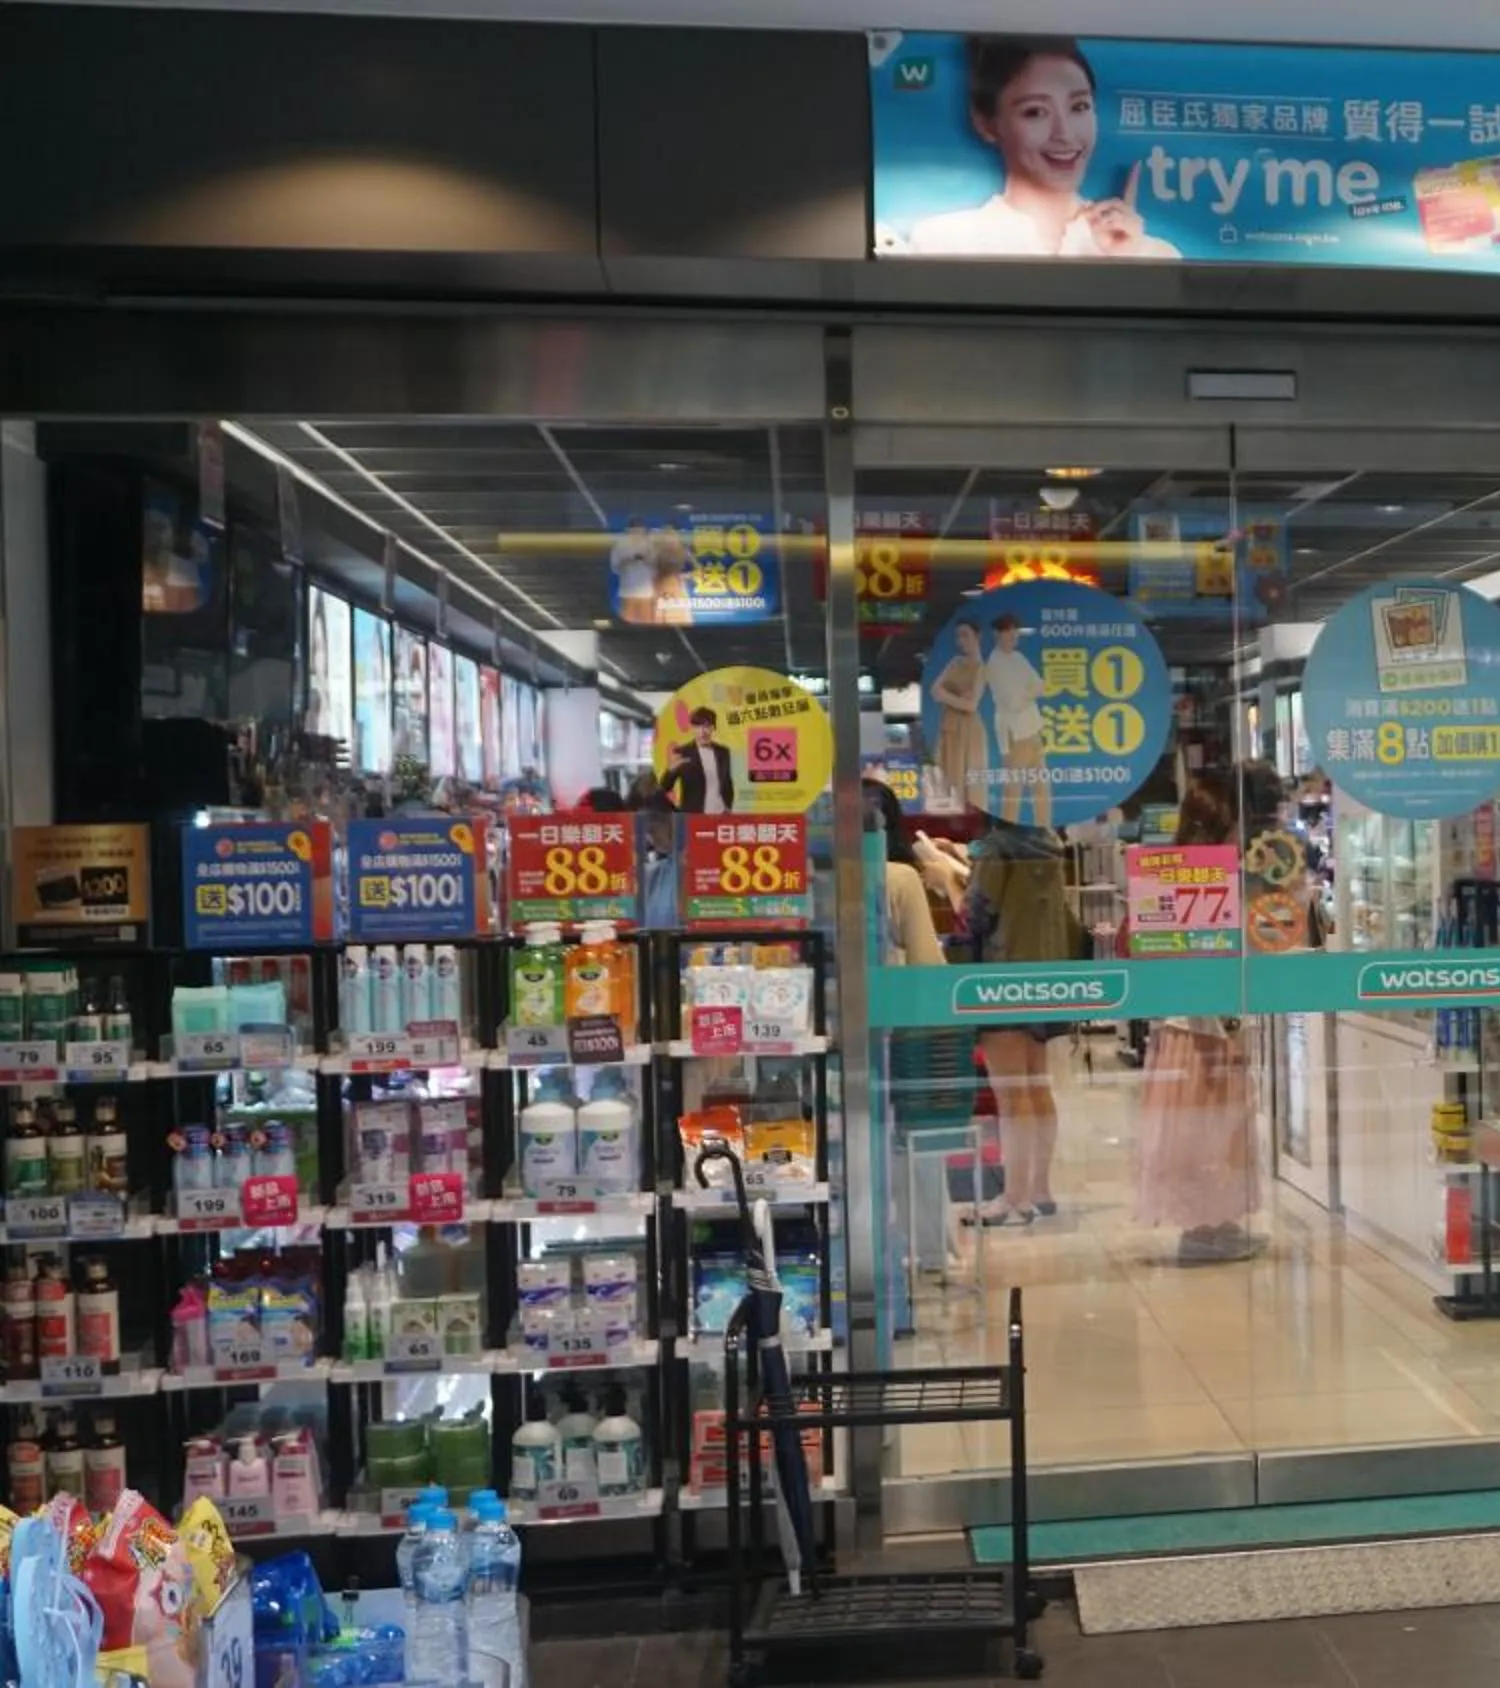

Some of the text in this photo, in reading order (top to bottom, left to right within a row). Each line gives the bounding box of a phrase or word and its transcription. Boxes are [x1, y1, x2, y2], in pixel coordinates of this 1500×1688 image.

[1120, 97, 1329, 134] 屈臣氏獨家品牌
[1146, 145, 1380, 214] try me
[755, 737, 793, 762] 6x
[517, 824, 624, 844] 一日樂翻天
[695, 824, 798, 844] 一日樂翻天
[1175, 887, 1229, 924] 77
[976, 977, 1105, 1003] watsons
[751, 1024, 780, 1037] 139
[203, 1041, 224, 1054] 65
[366, 1041, 396, 1054] 199
[562, 1337, 592, 1351] 135
[227, 1503, 259, 1518] 145
